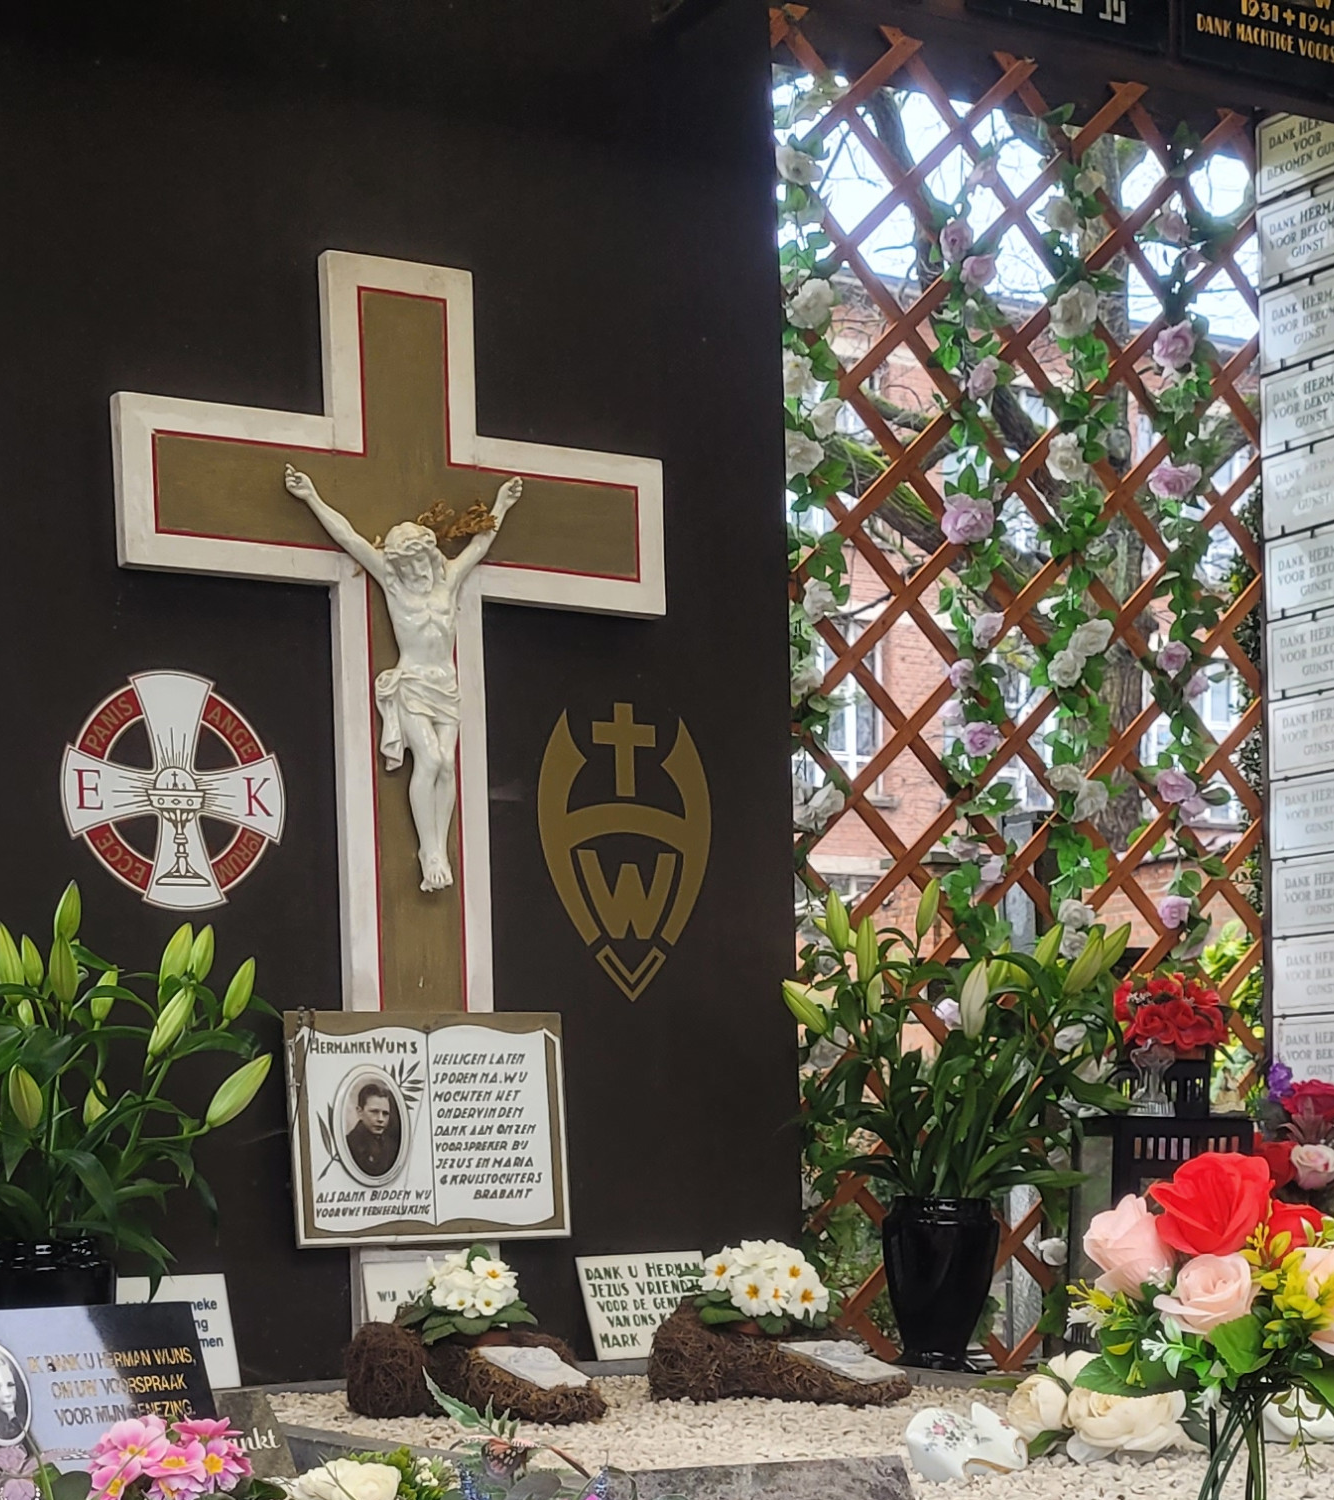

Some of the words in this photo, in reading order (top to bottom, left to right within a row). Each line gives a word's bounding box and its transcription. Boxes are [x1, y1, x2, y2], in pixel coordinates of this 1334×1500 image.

[1196, 13, 1232, 38] DANK
[85, 696, 133, 752] PANIS
[207, 705, 257, 759] ANGE
[72, 768, 104, 811] E
[242, 776, 274, 817] K
[96, 832, 148, 884] ECCE
[433, 1053, 487, 1065] HEILIGEN
[489, 1053, 525, 1065] LATEN
[432, 1072, 478, 1085] SPOREN
[433, 1090, 493, 1102] MOCHTEN
[495, 1090, 521, 1101] HET
[437, 1107, 524, 1119] ONDERVINDEN
[434, 1125, 467, 1136] DANK
[469, 1125, 494, 1135] AAN
[497, 1124, 537, 1135] ONZEN
[435, 1140, 508, 1152] VOORSPREKER
[436, 1157, 474, 1169] JEZUS
[475, 1157, 490, 1168] EN
[492, 1157, 534, 1168] MARIA
[450, 1172, 542, 1185] KRUISTOCHTERS
[316, 1192, 335, 1203] ALS
[337, 1192, 366, 1203] DANK
[370, 1190, 411, 1201] BIDDEN
[474, 1188, 533, 1199] BRABANT
[317, 1207, 340, 1219] VOOR
[341, 1206, 361, 1217] UWE
[584, 1267, 623, 1281] DANK
[628, 1265, 638, 1278] U
[588, 1283, 629, 1298] JEZUS
[597, 1300, 628, 1312] VOOR
[634, 1299, 647, 1310] DE
[606, 1314, 631, 1328] VAN
[633, 1314, 656, 1327] ONS
[599, 1333, 640, 1349] MARK
[84, 1354, 95, 1369] U
[98, 1350, 152, 1369] HERMAN
[51, 1380, 74, 1398] OM
[75, 1379, 98, 1396] UW
[101, 1373, 188, 1395] VOORSPRAAK
[54, 1406, 93, 1427] VOOR
[95, 1404, 126, 1422] MIJN
